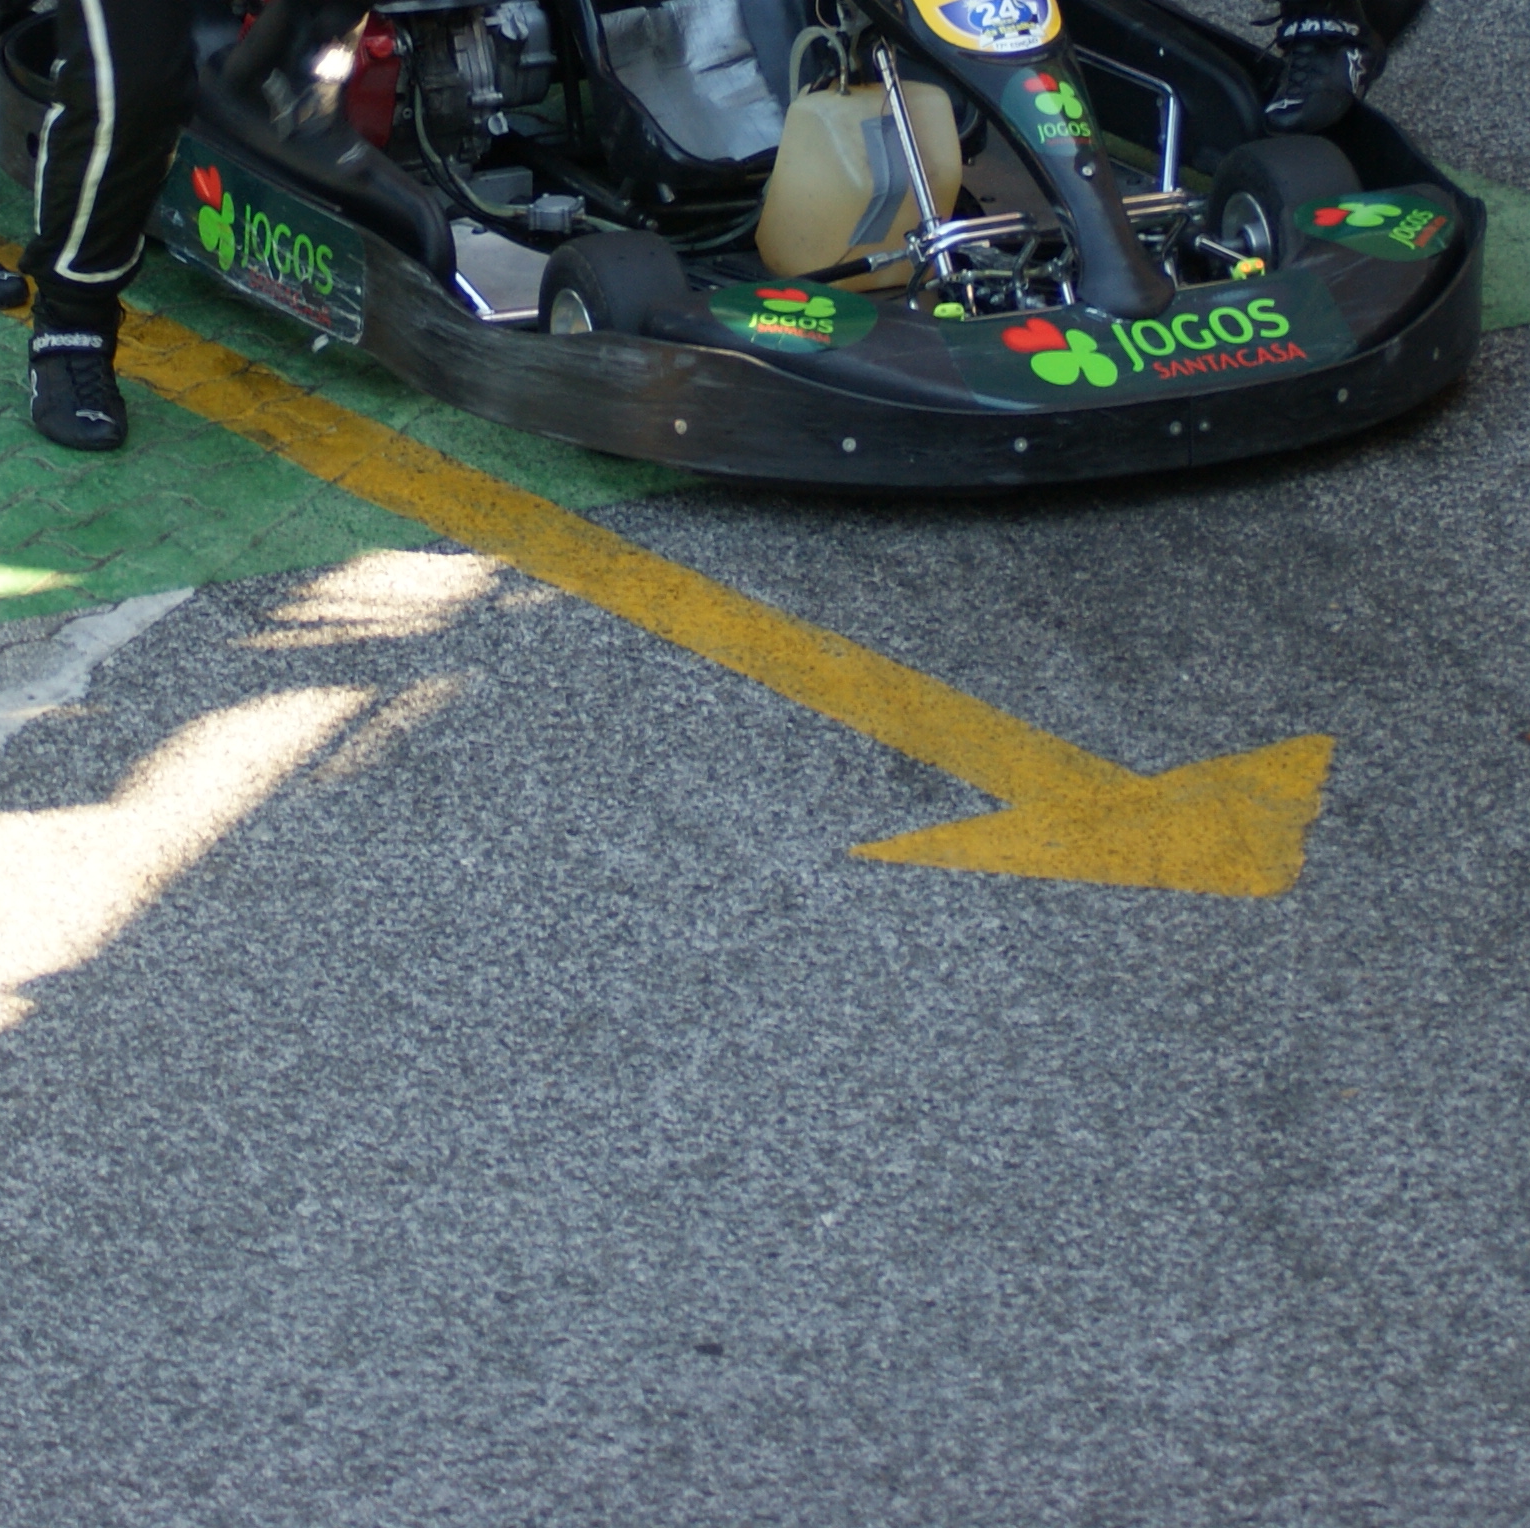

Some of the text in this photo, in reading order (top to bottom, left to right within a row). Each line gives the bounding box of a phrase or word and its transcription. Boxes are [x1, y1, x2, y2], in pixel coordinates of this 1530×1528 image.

[1037, 121, 1091, 144] JOGOS
[241, 203, 334, 295] JOGOS
[749, 313, 834, 334] JOGOS
[1111, 298, 1290, 372] JOGOS
[1153, 341, 1307, 379] SANTACASA
